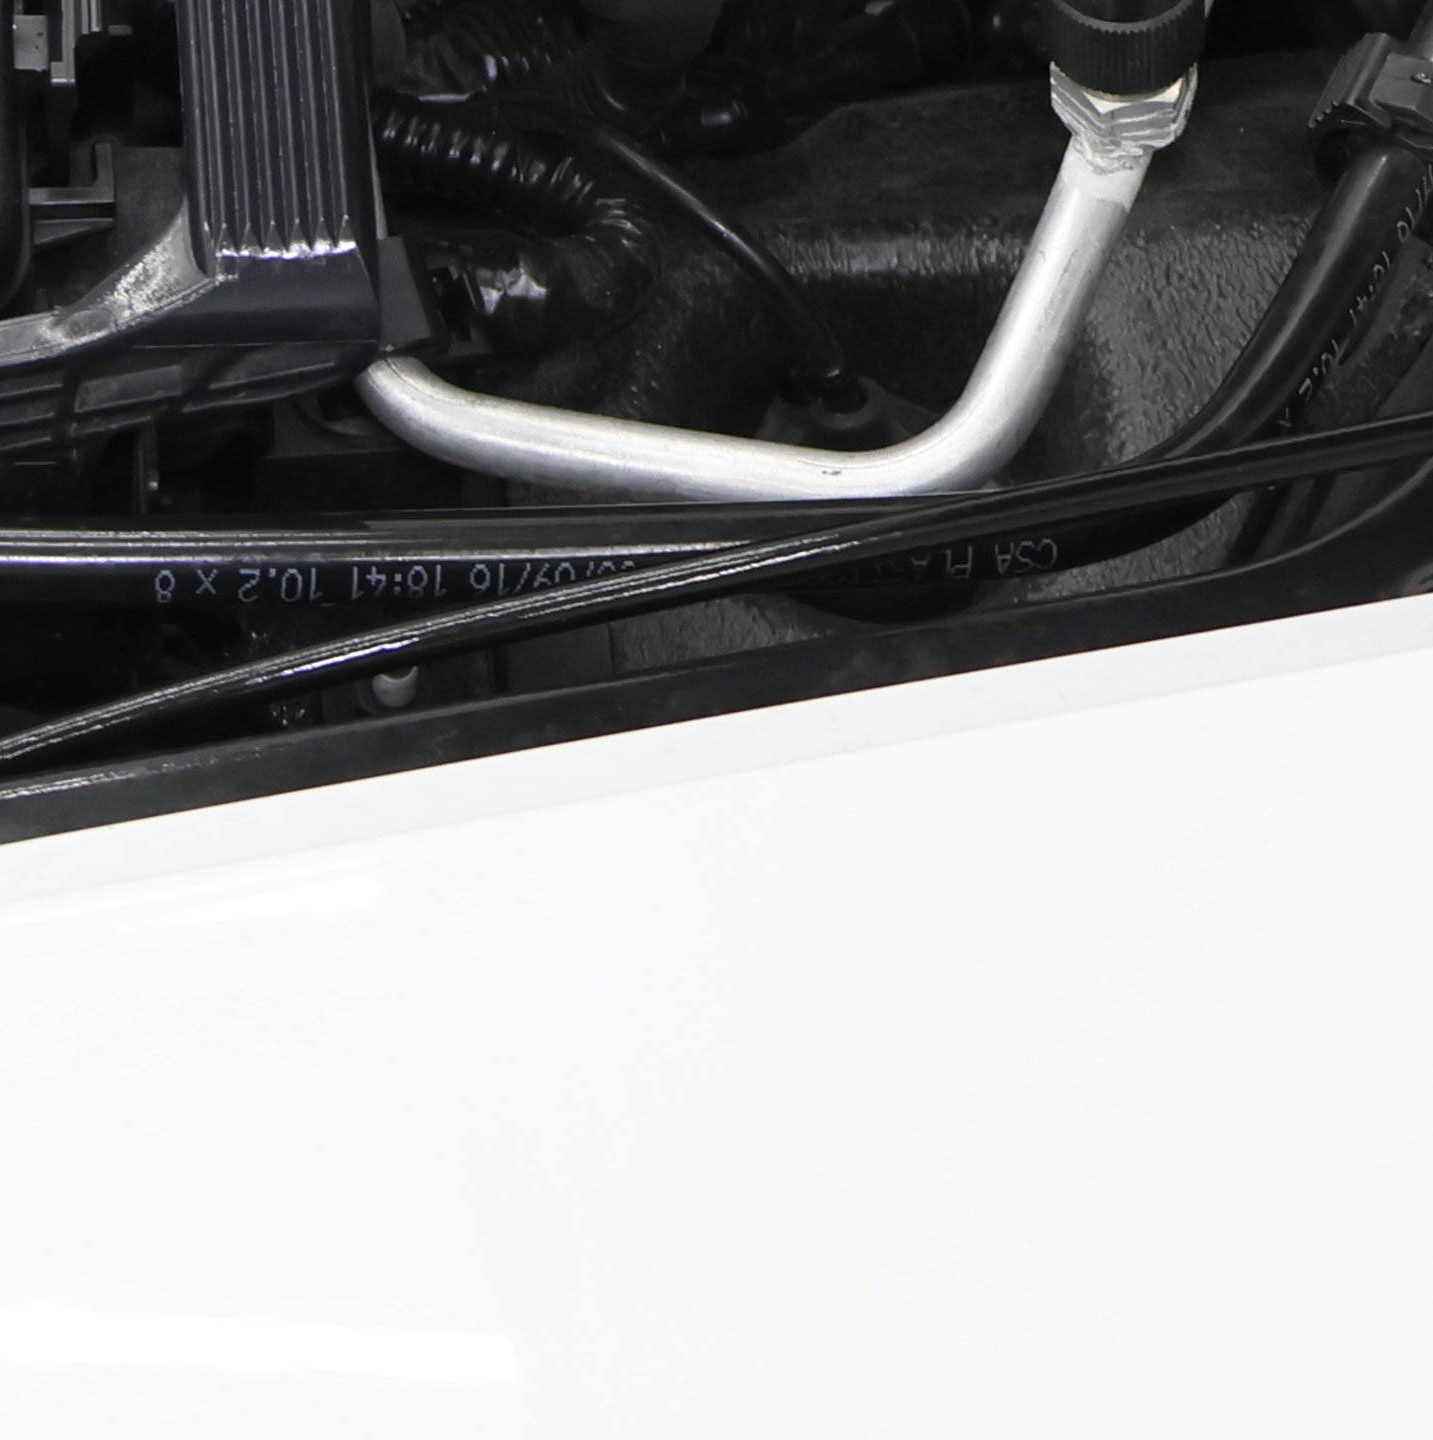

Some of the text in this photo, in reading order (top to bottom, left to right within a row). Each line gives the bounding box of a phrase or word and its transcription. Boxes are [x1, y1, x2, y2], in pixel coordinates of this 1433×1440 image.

[994, 538, 1057, 575] CSA
[154, 569, 175, 602] 8
[237, 567, 323, 602] 10.2
[349, 564, 448, 600] 18:41
